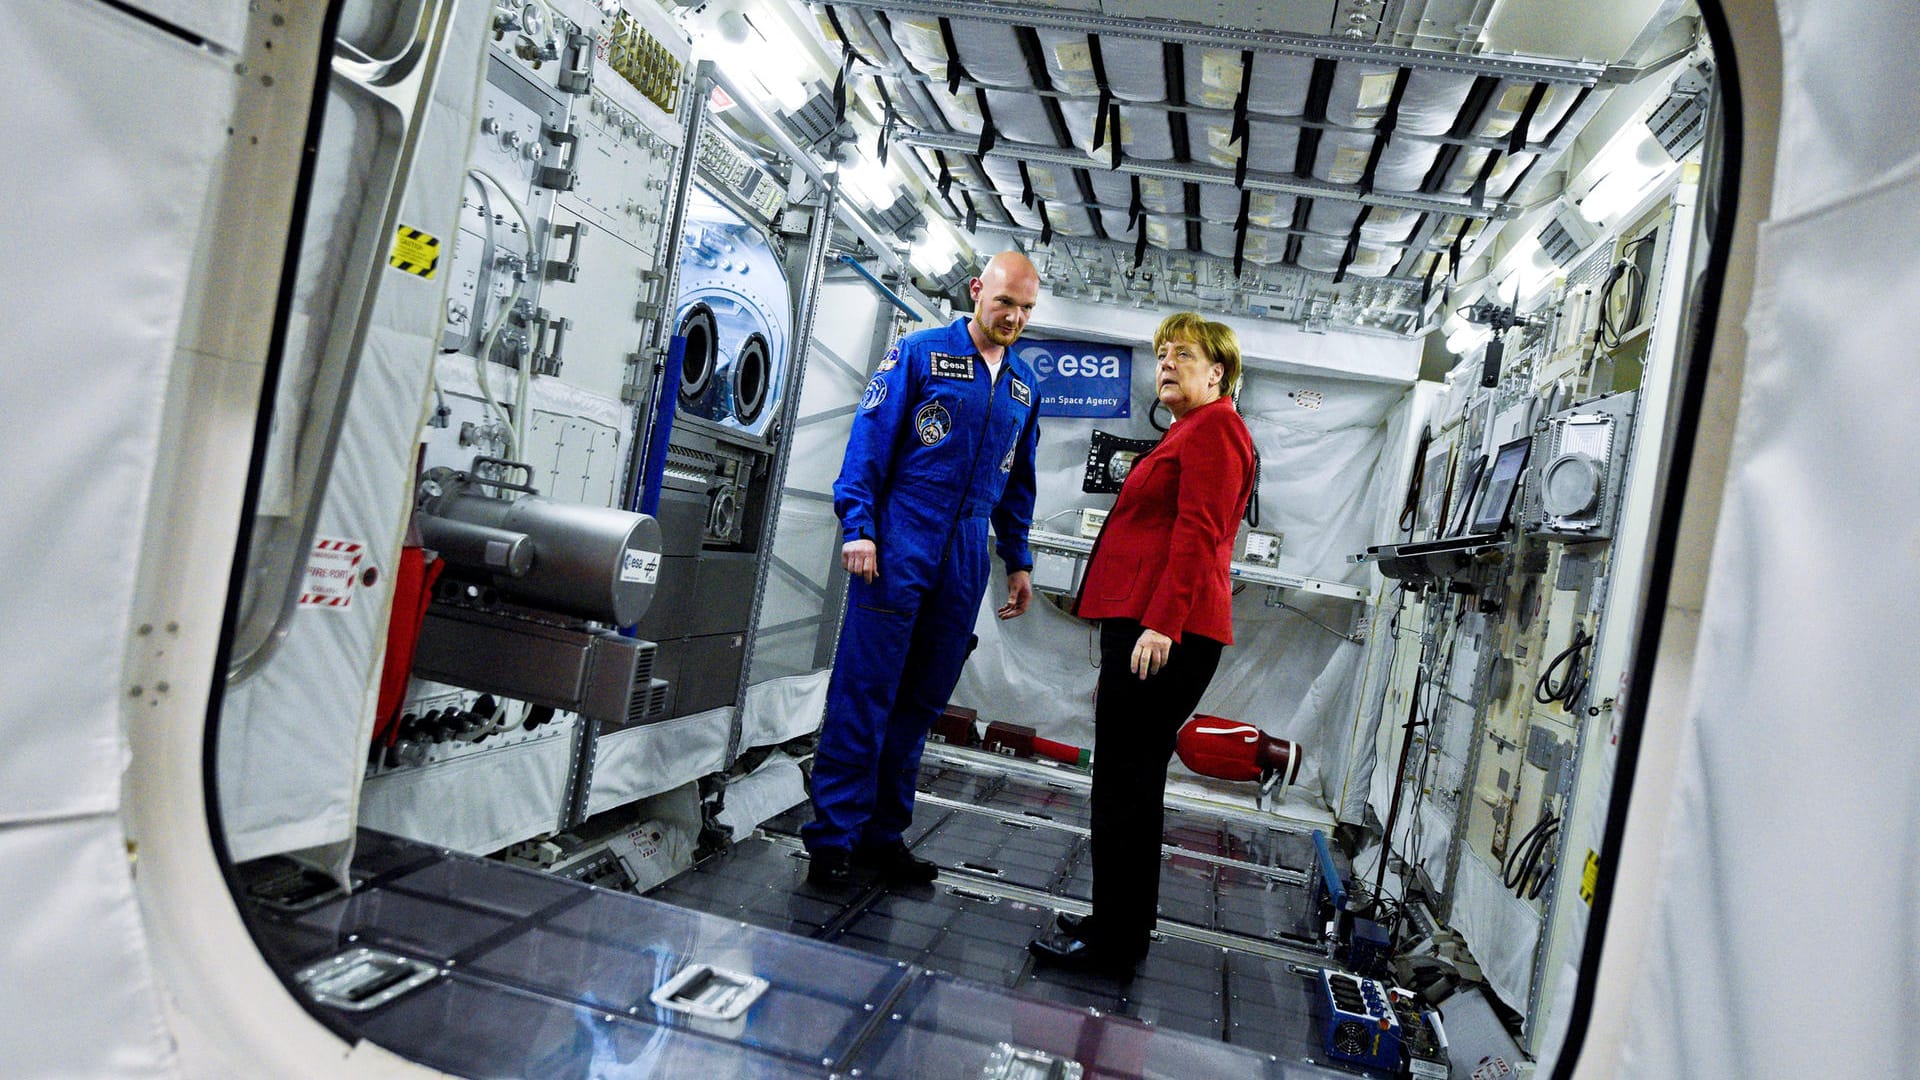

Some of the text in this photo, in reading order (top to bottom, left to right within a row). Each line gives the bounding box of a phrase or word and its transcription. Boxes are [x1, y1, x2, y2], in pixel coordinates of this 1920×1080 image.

[949, 360, 965, 370] esa
[1057, 354, 1120, 378] esa
[1058, 395, 1084, 406] Space
[1086, 396, 1118, 406] Agency
[631, 557, 643, 569] esa
